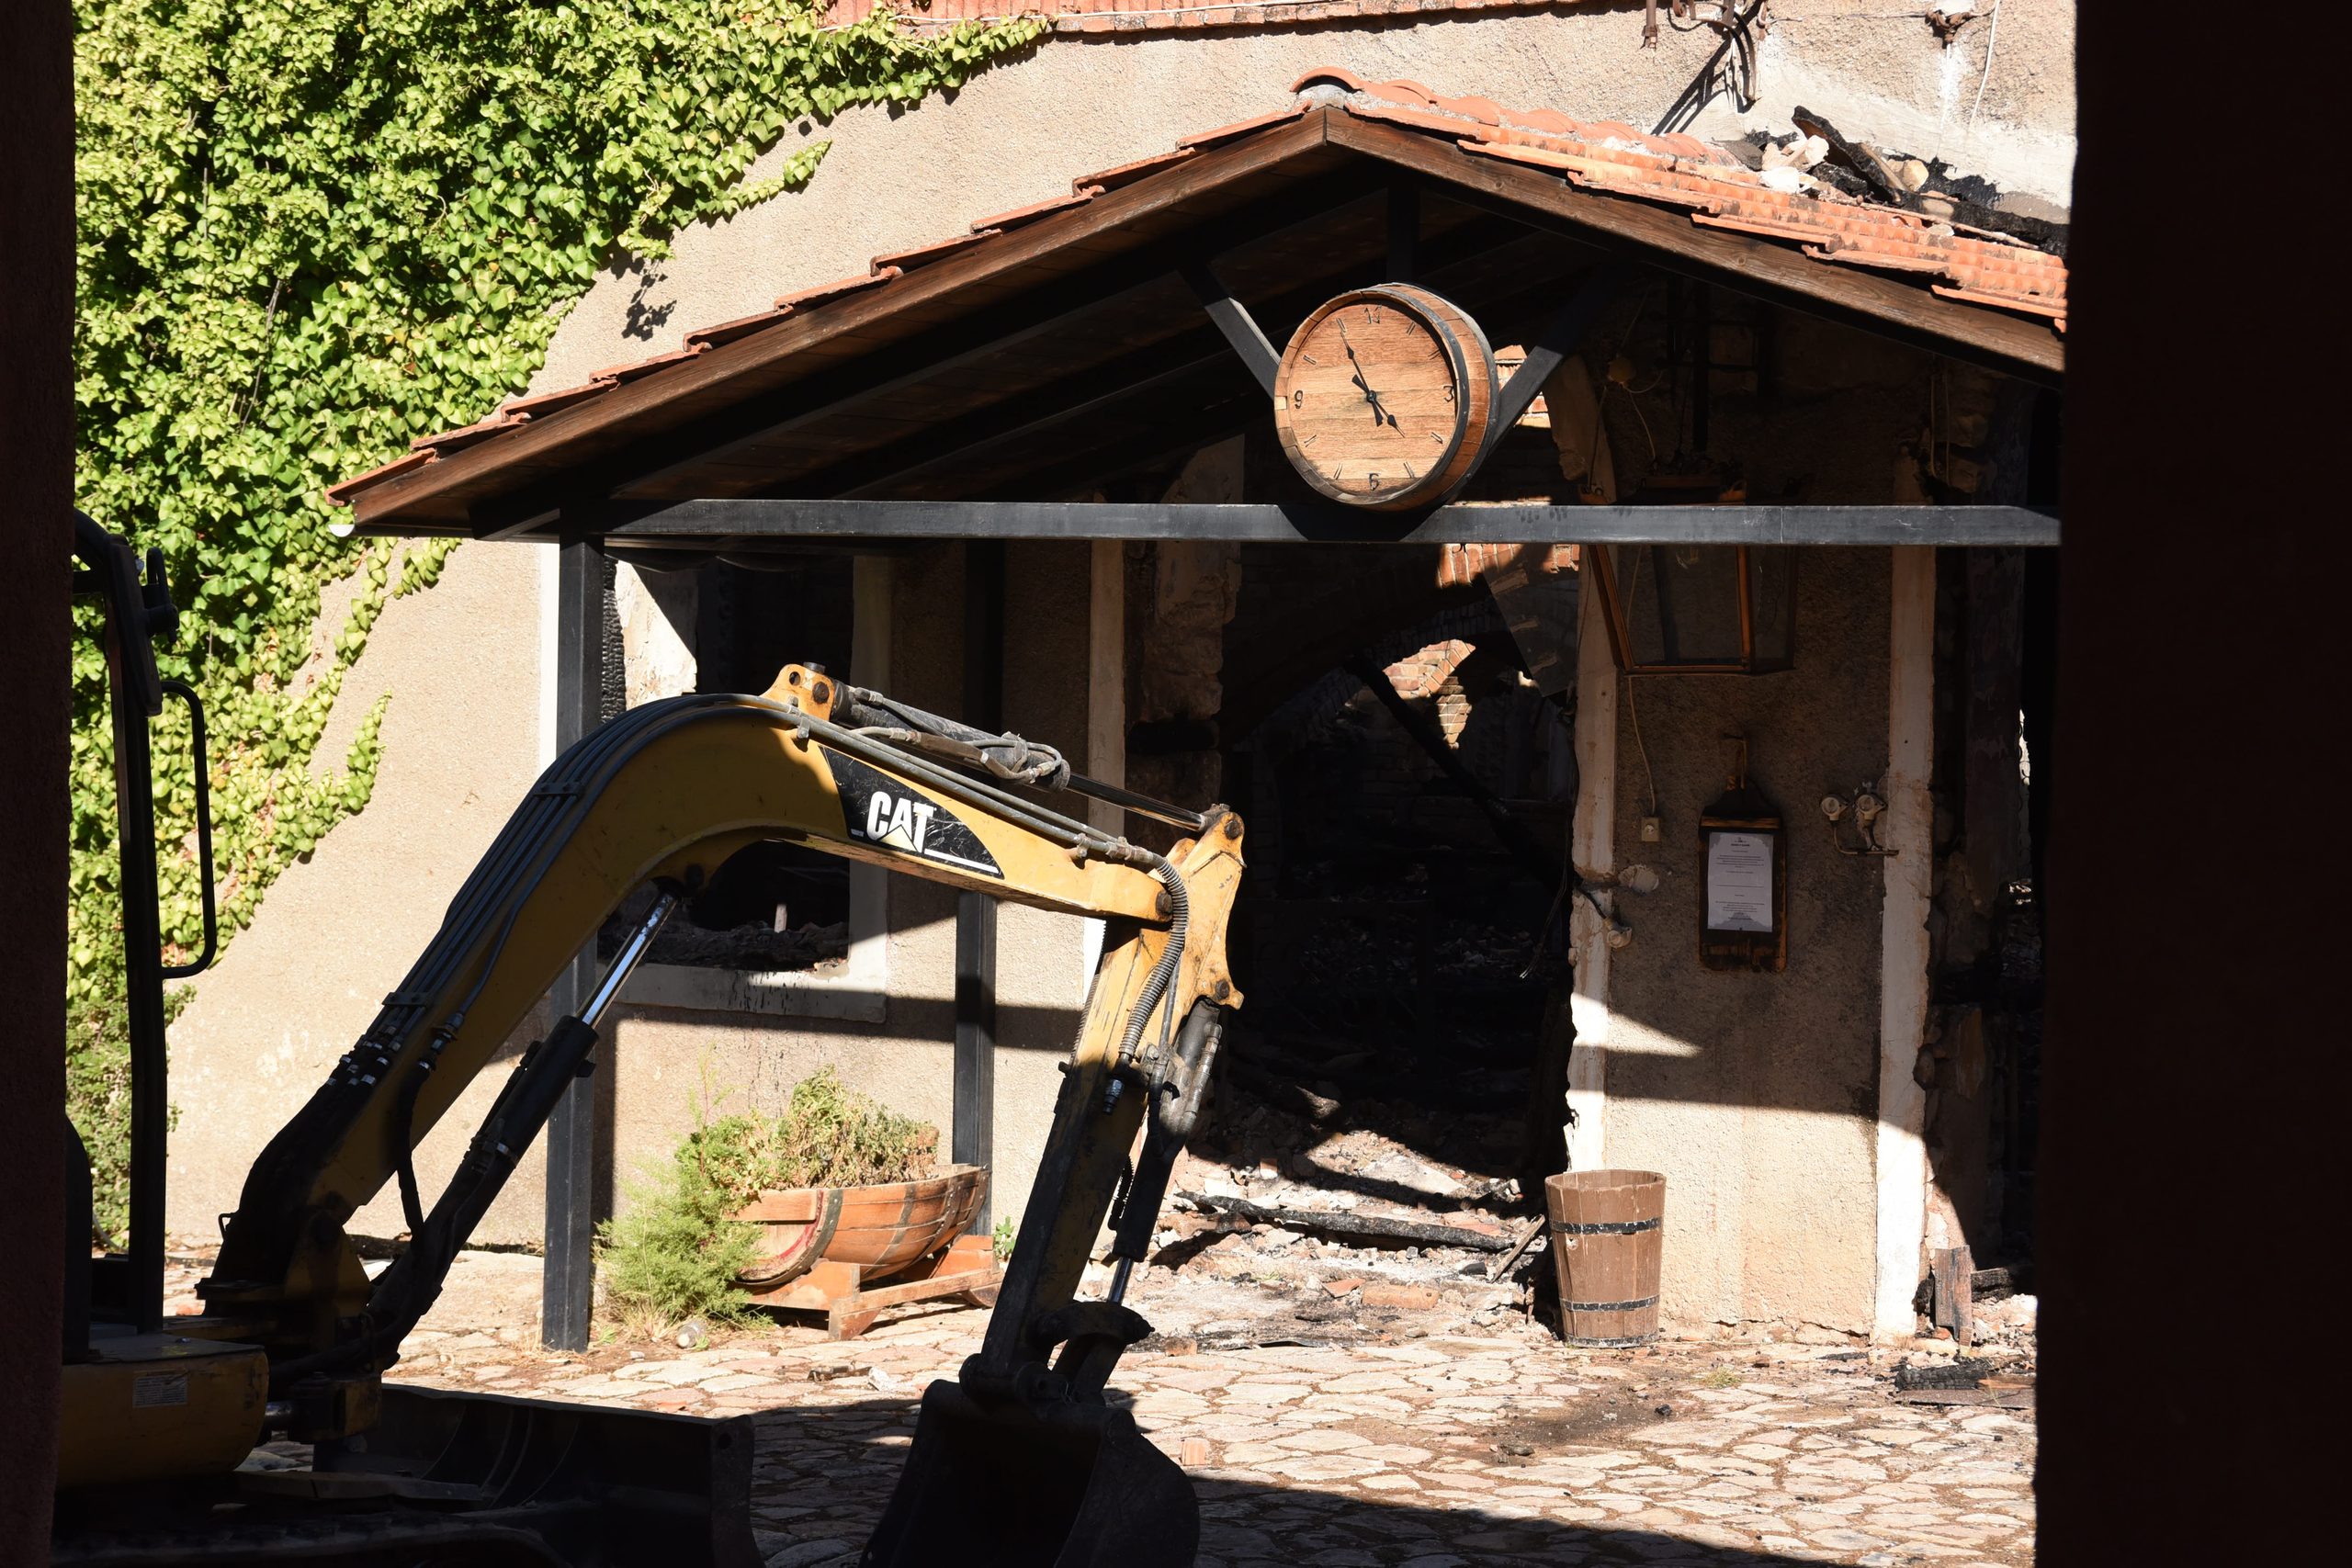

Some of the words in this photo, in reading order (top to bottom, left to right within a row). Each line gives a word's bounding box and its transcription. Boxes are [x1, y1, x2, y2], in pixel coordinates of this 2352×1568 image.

[1294, 389, 1304, 410] 9
[1443, 385, 1454, 402] 3
[866, 791, 934, 853] CAT
